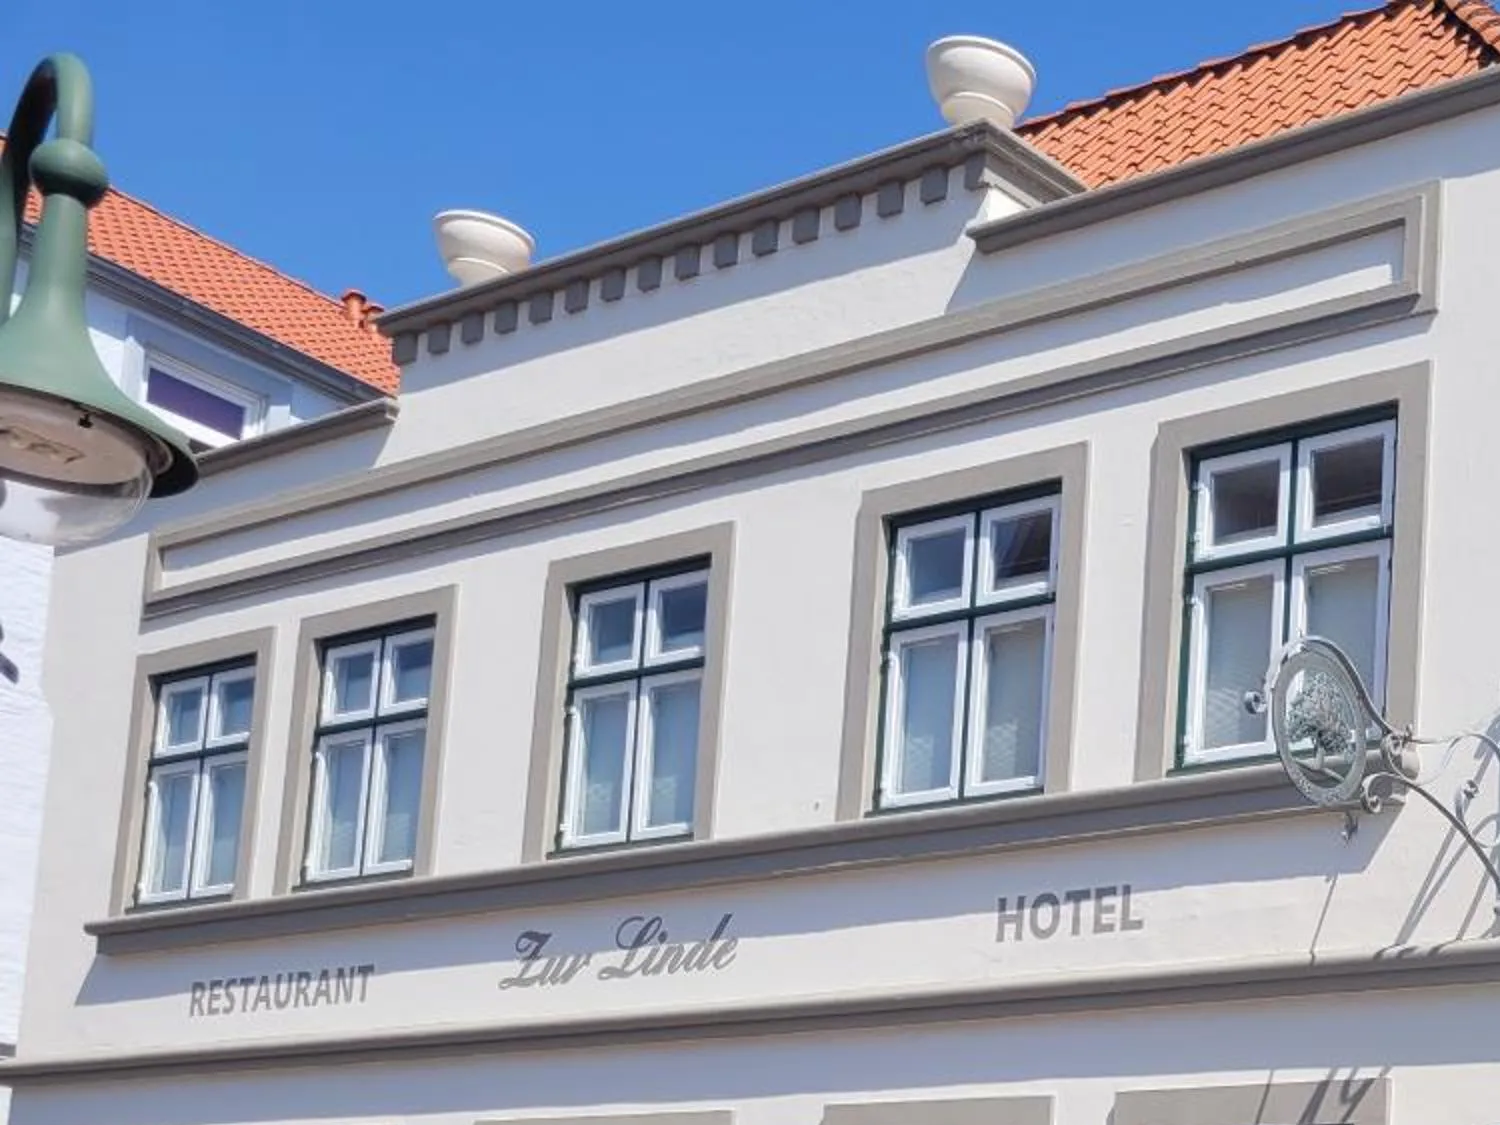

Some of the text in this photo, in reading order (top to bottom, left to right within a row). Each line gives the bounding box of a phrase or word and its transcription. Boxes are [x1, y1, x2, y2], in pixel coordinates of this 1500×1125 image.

[996, 884, 1144, 943] HOTEL
[498, 912, 738, 990] Zur Linde
[189, 963, 375, 1017] RESTAURANT
